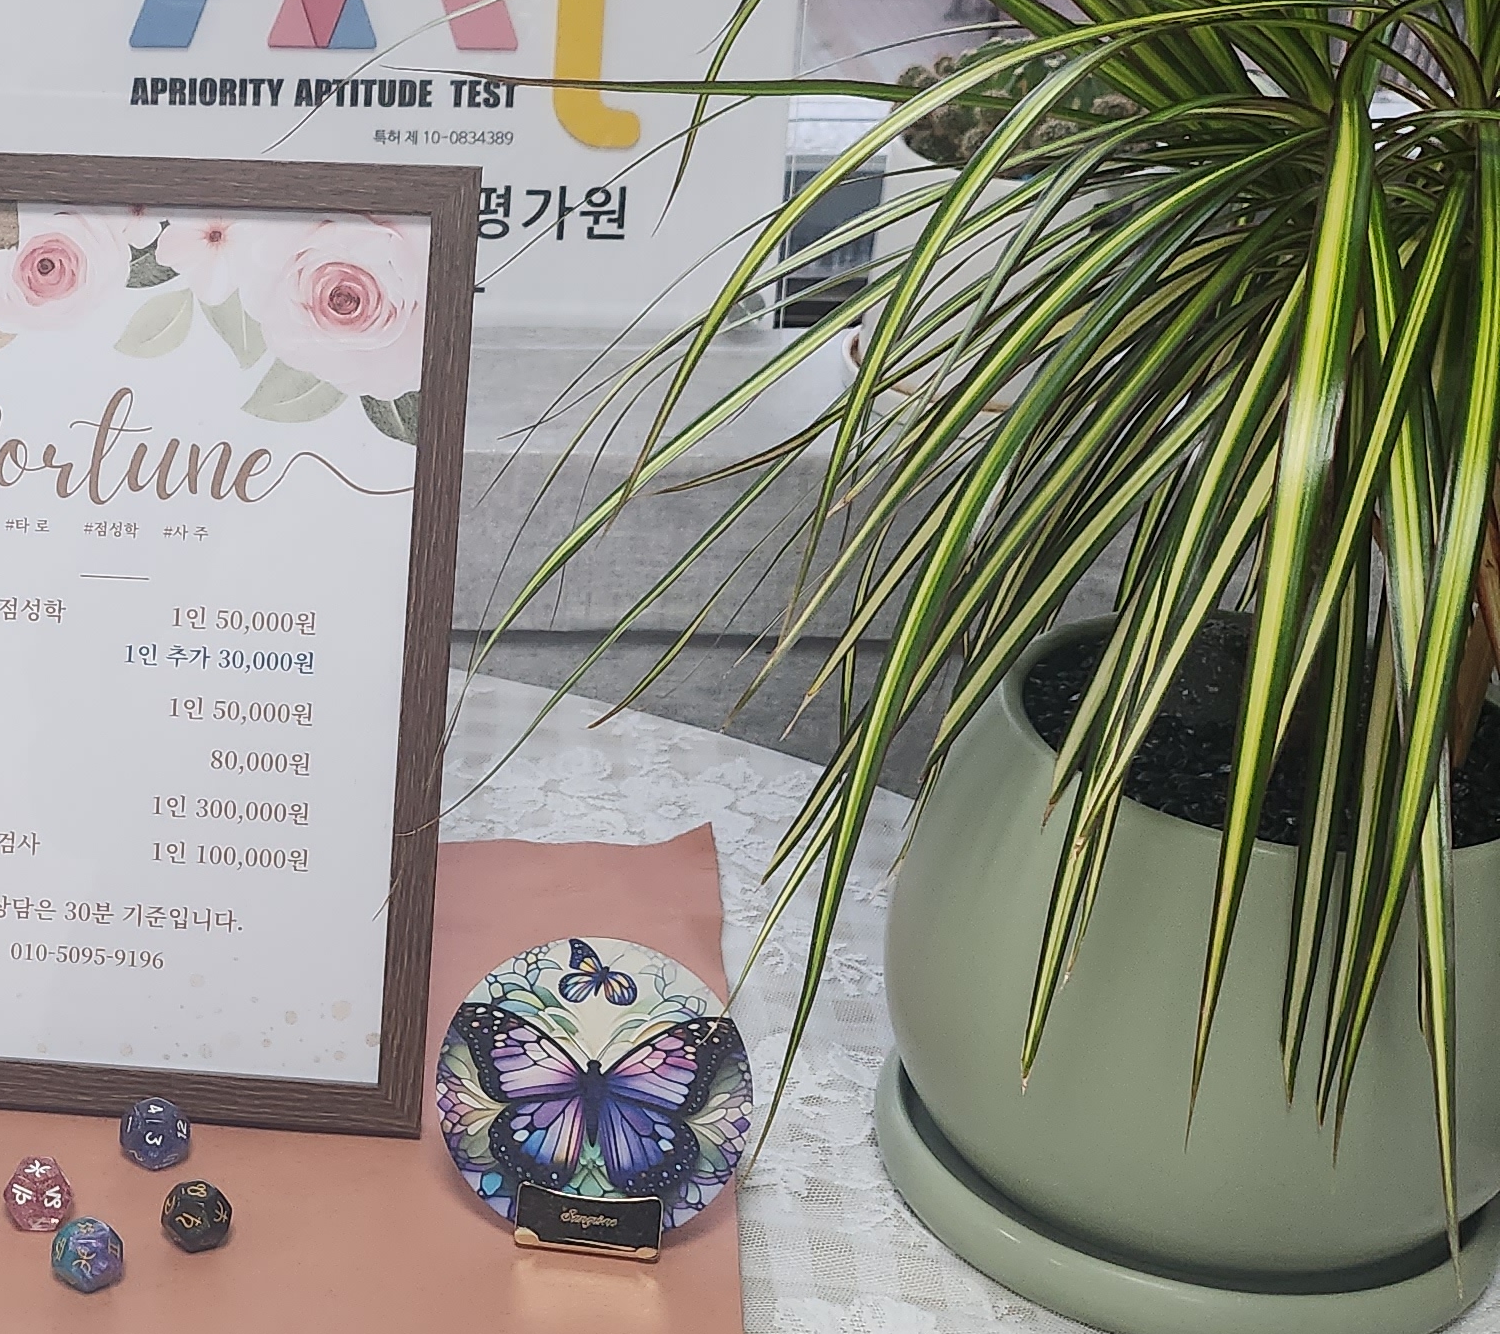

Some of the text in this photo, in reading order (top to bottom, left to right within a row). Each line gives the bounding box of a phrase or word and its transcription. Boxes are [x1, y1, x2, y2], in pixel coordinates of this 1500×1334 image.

[130, 76, 519, 109] APRIORITY APTITUDE TEST
[372, 128, 514, 146] 특허 제 10-0834389
[478, 184, 627, 241] 평가원
[82, 520, 140, 539] #점성학
[171, 605, 317, 636] 1인 50,000원
[123, 643, 315, 675] 1인 추가 30,000원
[169, 696, 313, 727] 1인 50,000원
[210, 749, 310, 777] 80,000원
[152, 794, 309, 826] 1인 300,000원
[152, 841, 309, 873] 1인 100,000원
[64, 901, 115, 925] 30분
[122, 903, 244, 934] 기준입니다.
[9, 942, 165, 970] 010-5095-9196
